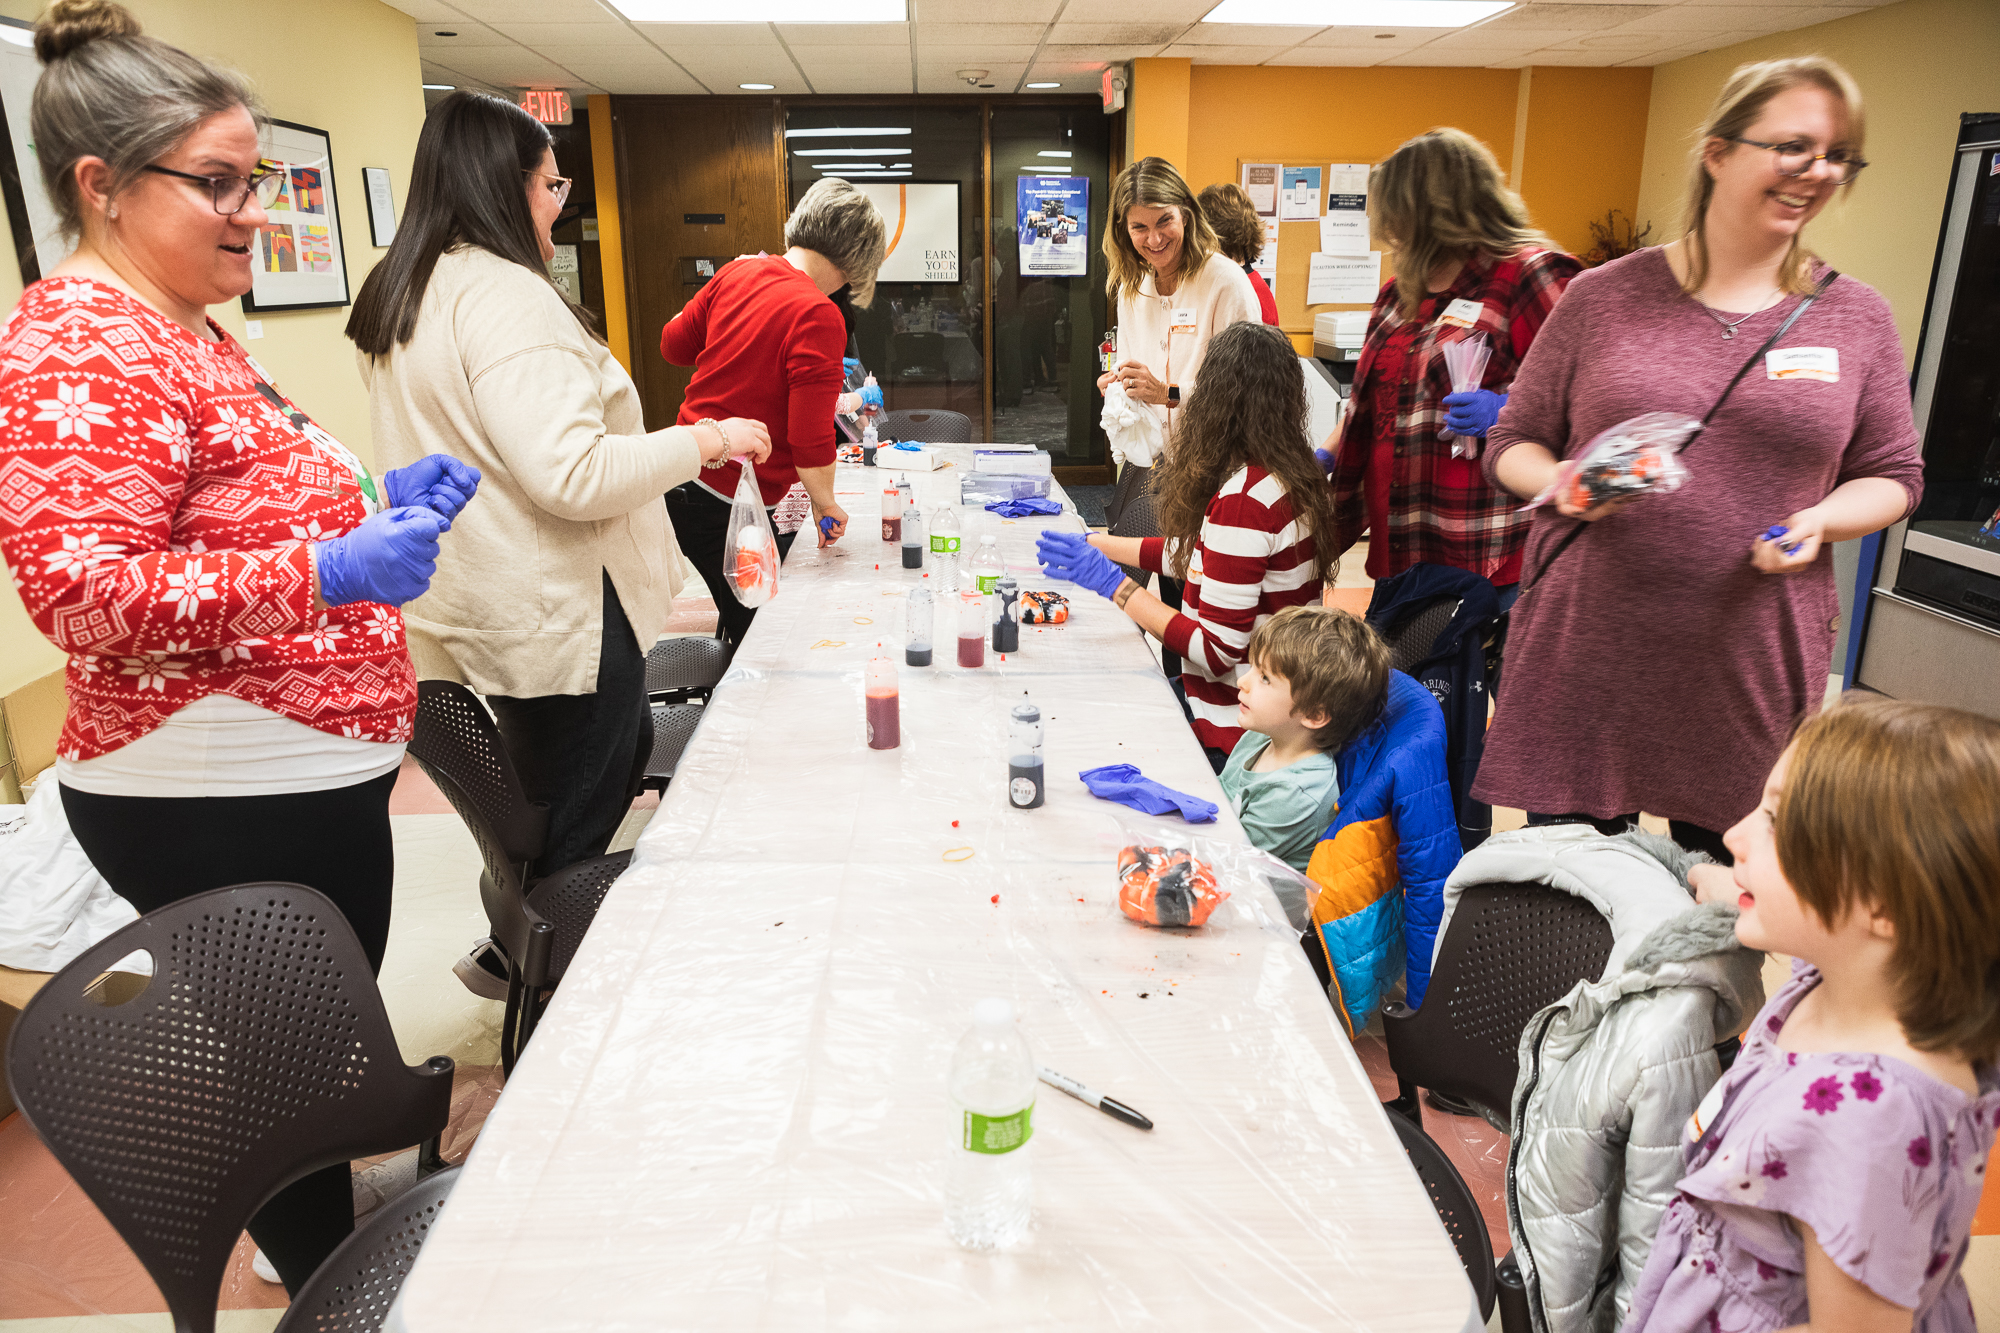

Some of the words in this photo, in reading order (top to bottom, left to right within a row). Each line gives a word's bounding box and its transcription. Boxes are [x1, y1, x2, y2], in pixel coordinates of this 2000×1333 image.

[526, 91, 563, 122] EXIT
[925, 250, 956, 259] EARN
[1423, 679, 1451, 694] ARINES
